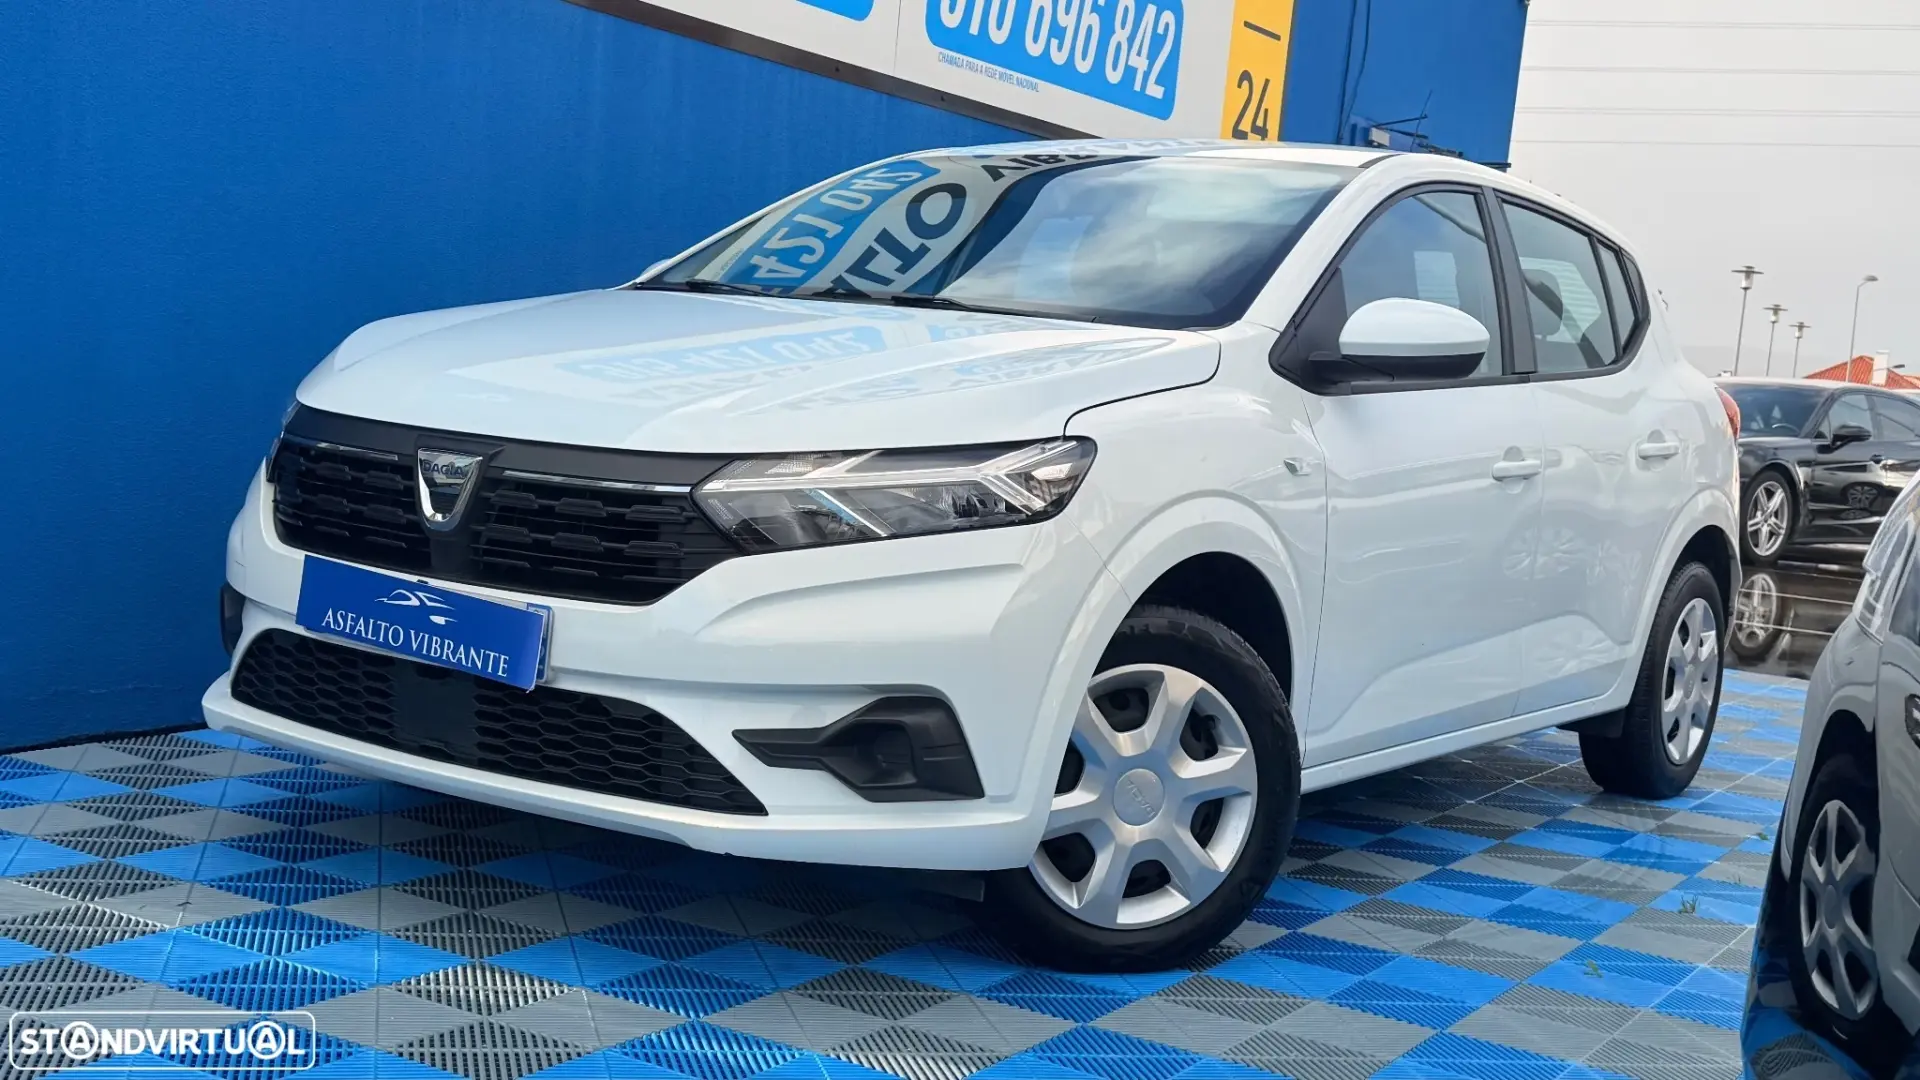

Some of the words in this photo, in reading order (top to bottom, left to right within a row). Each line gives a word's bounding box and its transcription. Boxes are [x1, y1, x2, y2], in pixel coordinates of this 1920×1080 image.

[937, 51, 965, 69] CHAMADA
[965, 60, 980, 74] PARA
[984, 65, 998, 79] REDE
[1014, 75, 1040, 93] NACIONAL
[1105, 0, 1176, 99] 842
[1231, 69, 1270, 140] 24
[422, 459, 465, 476] DACIA
[321, 607, 404, 647] ASFALTO
[409, 629, 510, 677] VIBRANTE
